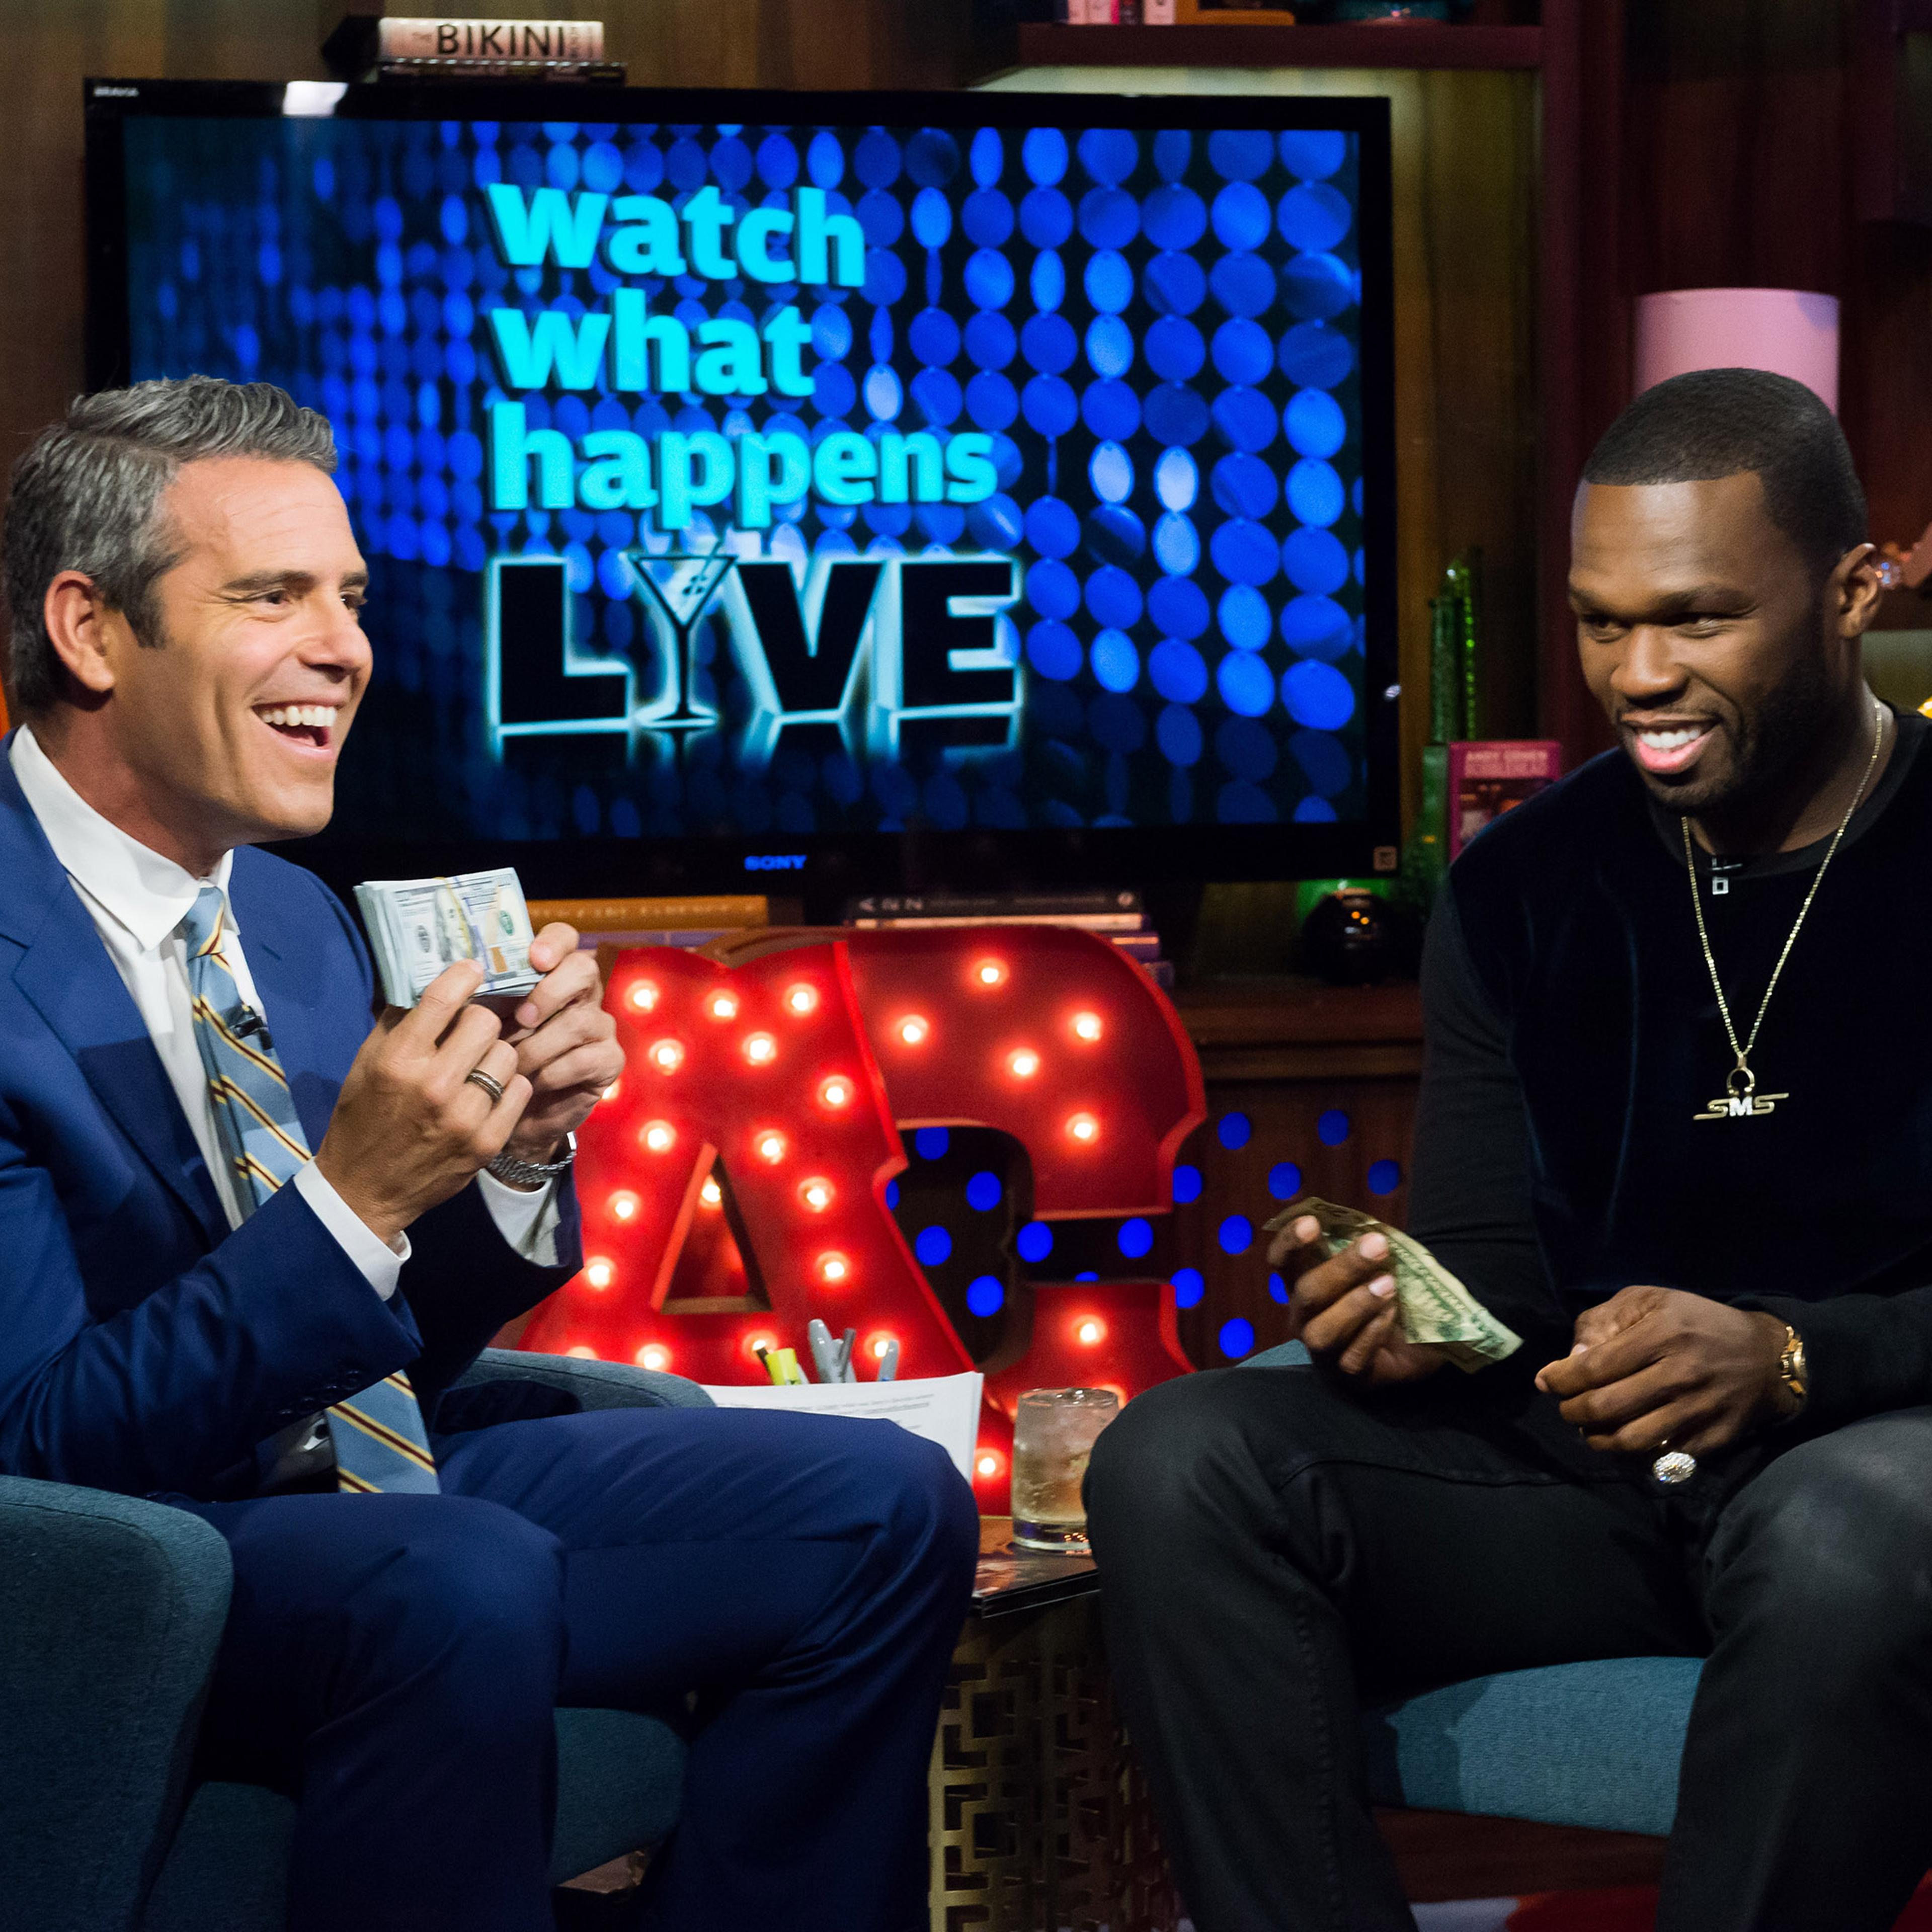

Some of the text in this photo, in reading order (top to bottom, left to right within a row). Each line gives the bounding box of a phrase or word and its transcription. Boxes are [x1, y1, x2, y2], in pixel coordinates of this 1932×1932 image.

[437, 23, 564, 56] BIKINI
[490, 287, 816, 397] what
[490, 401, 999, 530] happens
[490, 552, 1021, 736] LIVE
[744, 854, 808, 871] SONY
[1693, 1092, 1790, 1120] SMS
